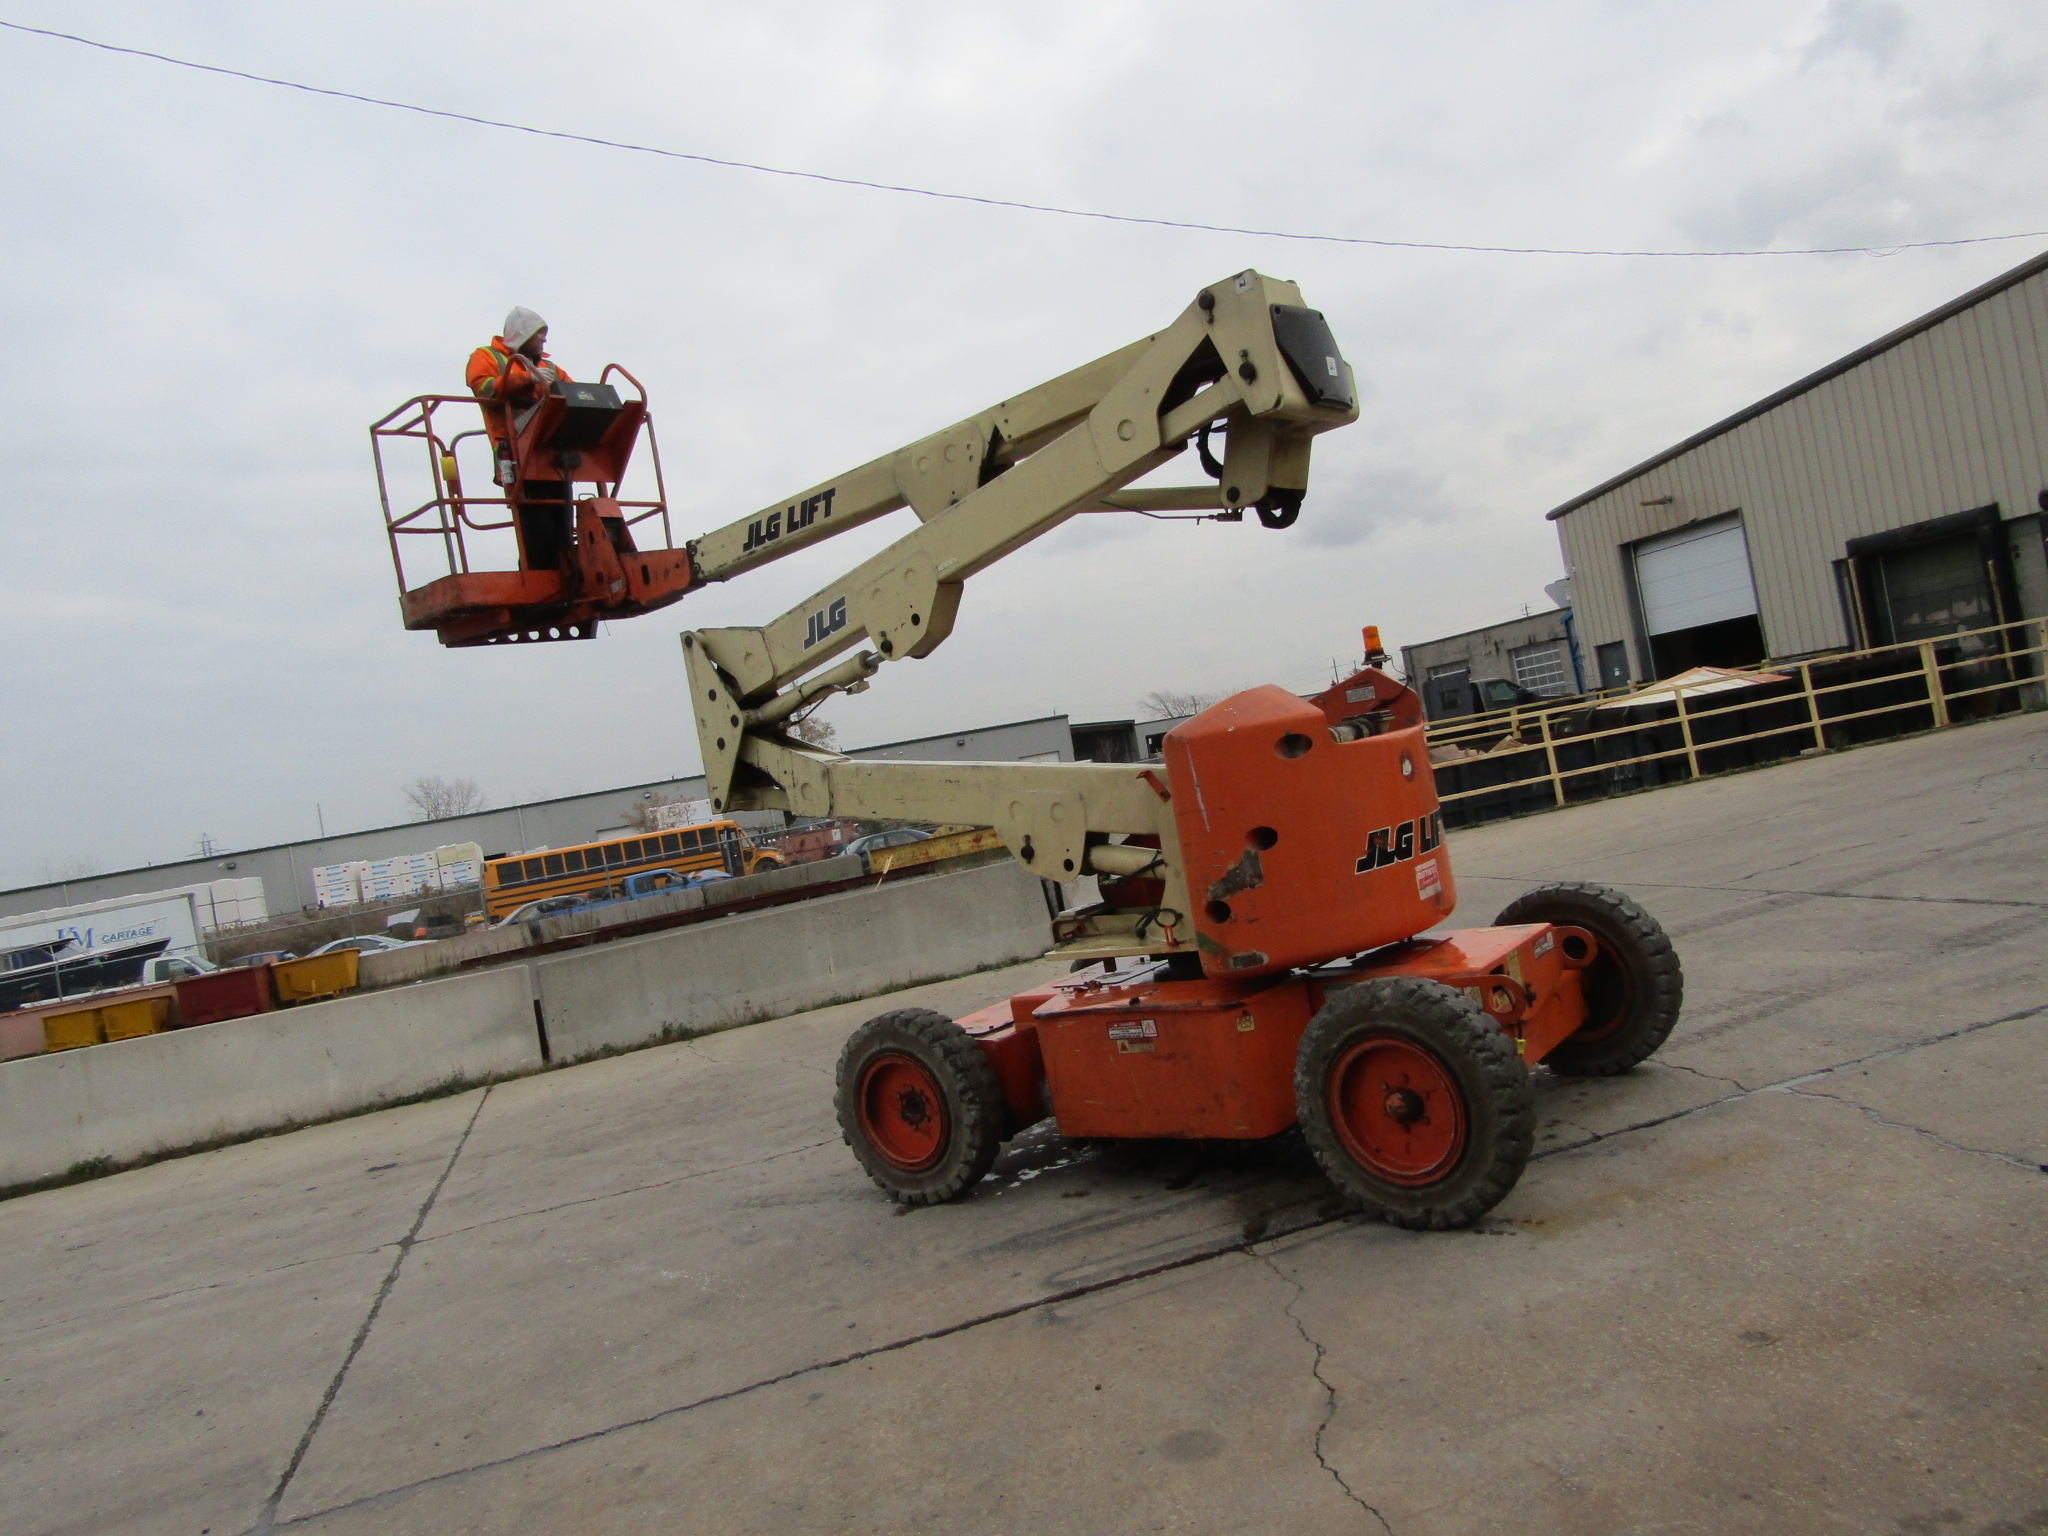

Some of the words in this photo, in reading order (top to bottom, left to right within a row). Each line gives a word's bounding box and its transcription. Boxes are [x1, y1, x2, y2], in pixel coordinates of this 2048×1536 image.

[743, 511, 781, 552] JLG
[787, 487, 836, 534] LIFT
[803, 595, 847, 650] JLG
[1355, 819, 1414, 875] JLG
[1419, 806, 1441, 855] LIF
[101, 926, 154, 943] CARTAGE
